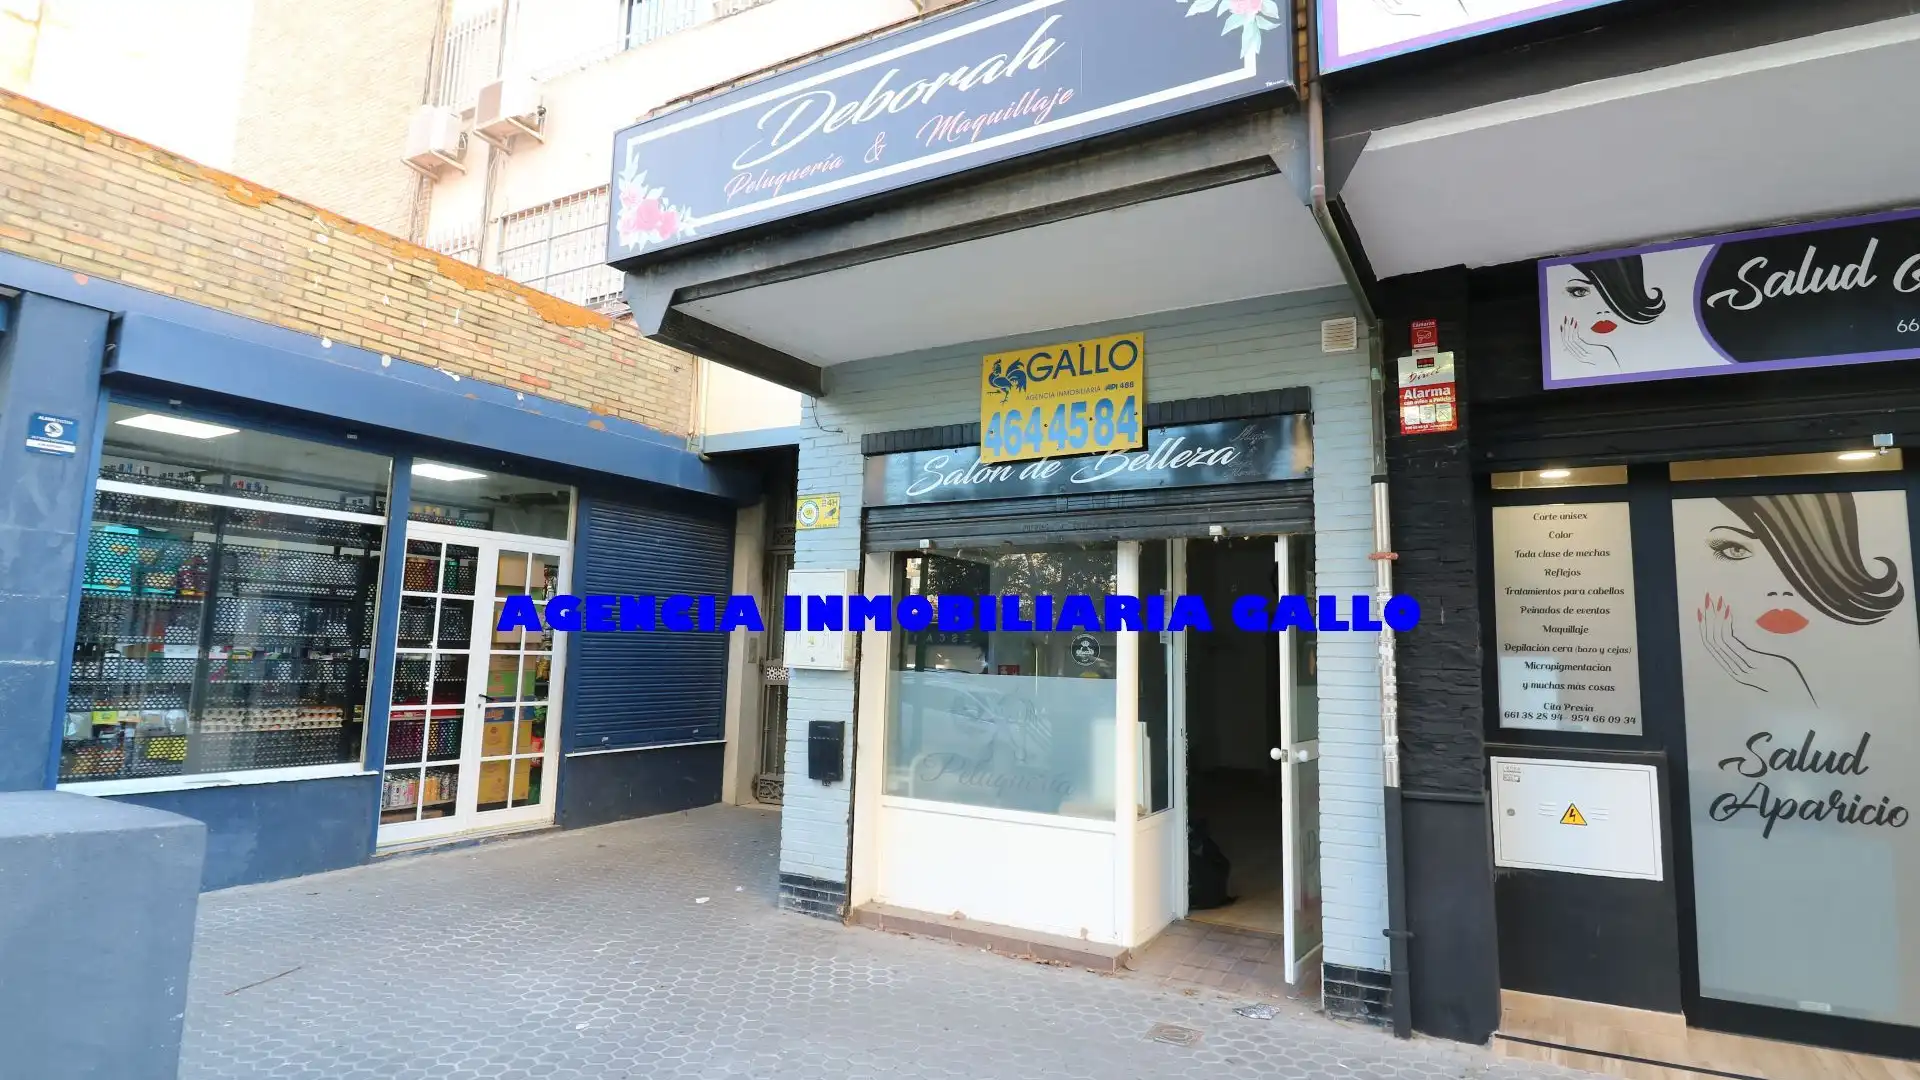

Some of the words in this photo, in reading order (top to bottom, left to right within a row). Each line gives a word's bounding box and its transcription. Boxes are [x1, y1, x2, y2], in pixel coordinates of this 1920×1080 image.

[732, 14, 1067, 171] Deborah
[724, 154, 844, 203] Peluquería
[864, 132, 887, 164] &
[916, 87, 1075, 148] Maquillaje
[1706, 237, 1879, 311] Salud
[1026, 339, 1139, 383] GALLO
[1025, 390, 1056, 401] AGENCIA
[1404, 386, 1451, 400] Alarma
[1019, 457, 1054, 481] de
[1533, 512, 1558, 521] Corte
[1559, 512, 1588, 521] unisex
[1548, 530, 1574, 540] Color
[1514, 549, 1536, 559] Toda
[1538, 548, 1561, 558] clase
[1562, 548, 1574, 558] de
[1575, 548, 1610, 558] mechas
[1544, 568, 1582, 578] Reflejos
[1504, 586, 1562, 597] Tratamientos
[1563, 588, 1586, 598] para
[1587, 586, 1625, 597] cabellos
[1519, 605, 1562, 615] Peinados
[1563, 605, 1575, 615] de
[1576, 606, 1611, 615] eventos
[1542, 624, 1589, 636] Maquillaje
[1552, 645, 1574, 653] cera
[1599, 646, 1606, 655] y
[1607, 645, 1633, 655] cejas)
[1522, 682, 1530, 691] y
[1530, 681, 1566, 691] muchas
[1588, 684, 1616, 693] cosas
[1543, 702, 1561, 711] Cita
[1563, 703, 1594, 713] Previa
[1504, 711, 1519, 719] 661
[1521, 711, 1534, 720] 38
[1535, 712, 1549, 721] 28
[1550, 713, 1563, 722] 94
[1571, 714, 1590, 722] 954
[1592, 715, 1606, 724] 66
[1607, 716, 1622, 725] 09
[1623, 716, 1637, 725] 34
[1718, 729, 1871, 778] Salud
[1709, 782, 1909, 839] Aparicio
